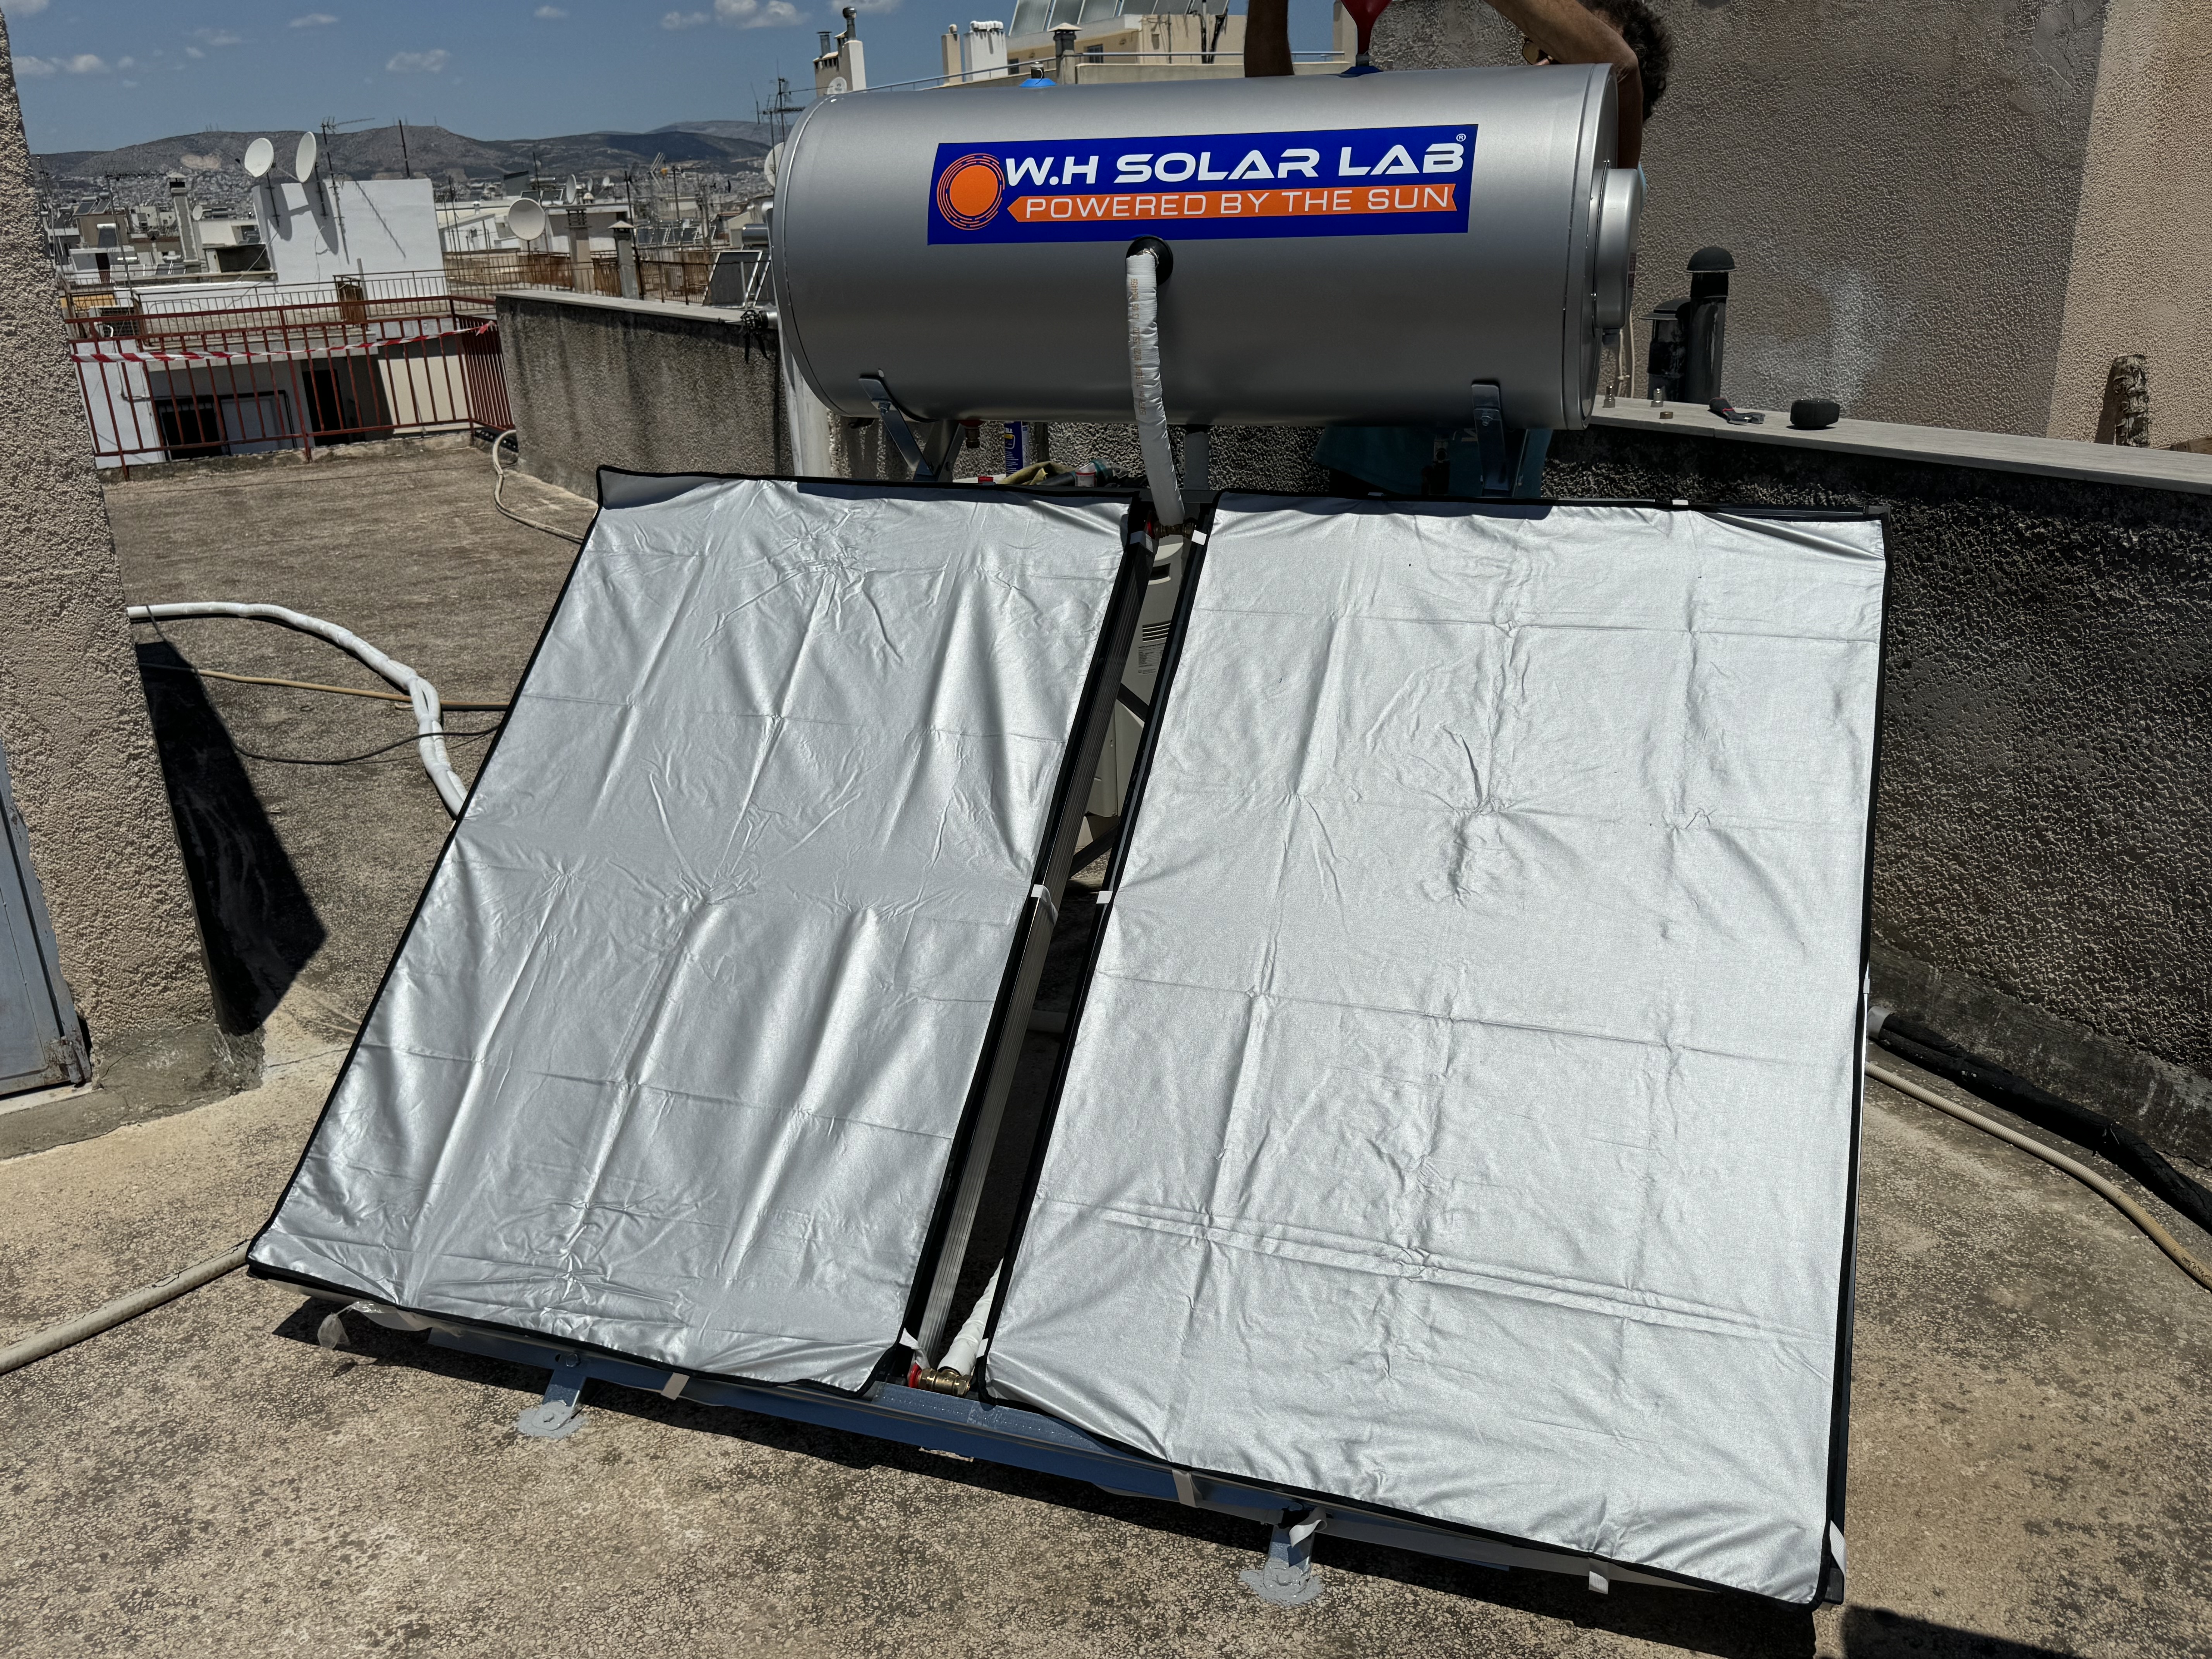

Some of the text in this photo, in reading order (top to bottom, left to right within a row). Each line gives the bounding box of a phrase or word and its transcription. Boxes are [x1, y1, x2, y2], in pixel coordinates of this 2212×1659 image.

[1006, 155, 1099, 186] W.H
[1113, 148, 1320, 184] SOLAR
[1026, 187, 1448, 218] POWERED BY THE SUN
